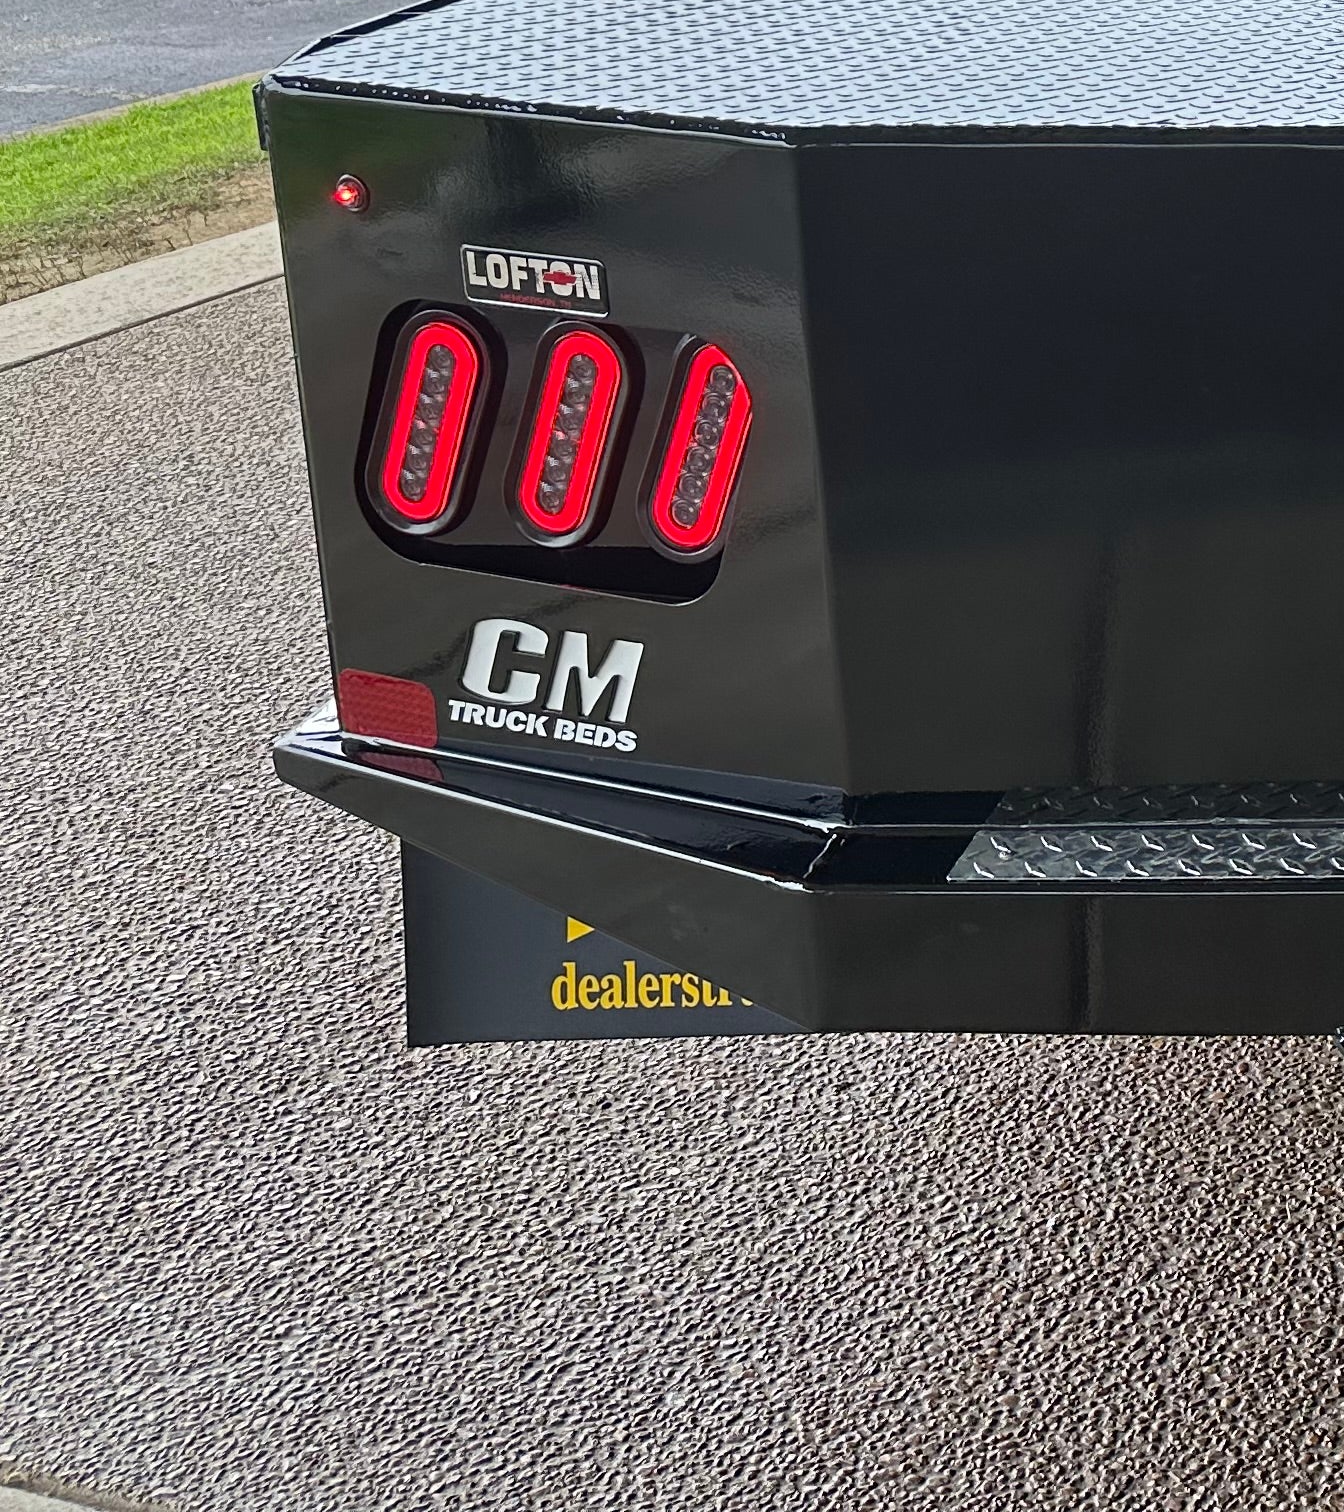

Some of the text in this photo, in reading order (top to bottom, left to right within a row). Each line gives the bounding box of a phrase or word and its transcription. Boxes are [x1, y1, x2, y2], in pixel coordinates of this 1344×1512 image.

[466, 251, 601, 300] LOFTON
[462, 618, 644, 723] CM
[448, 699, 638, 752] TRUCK BEDS
